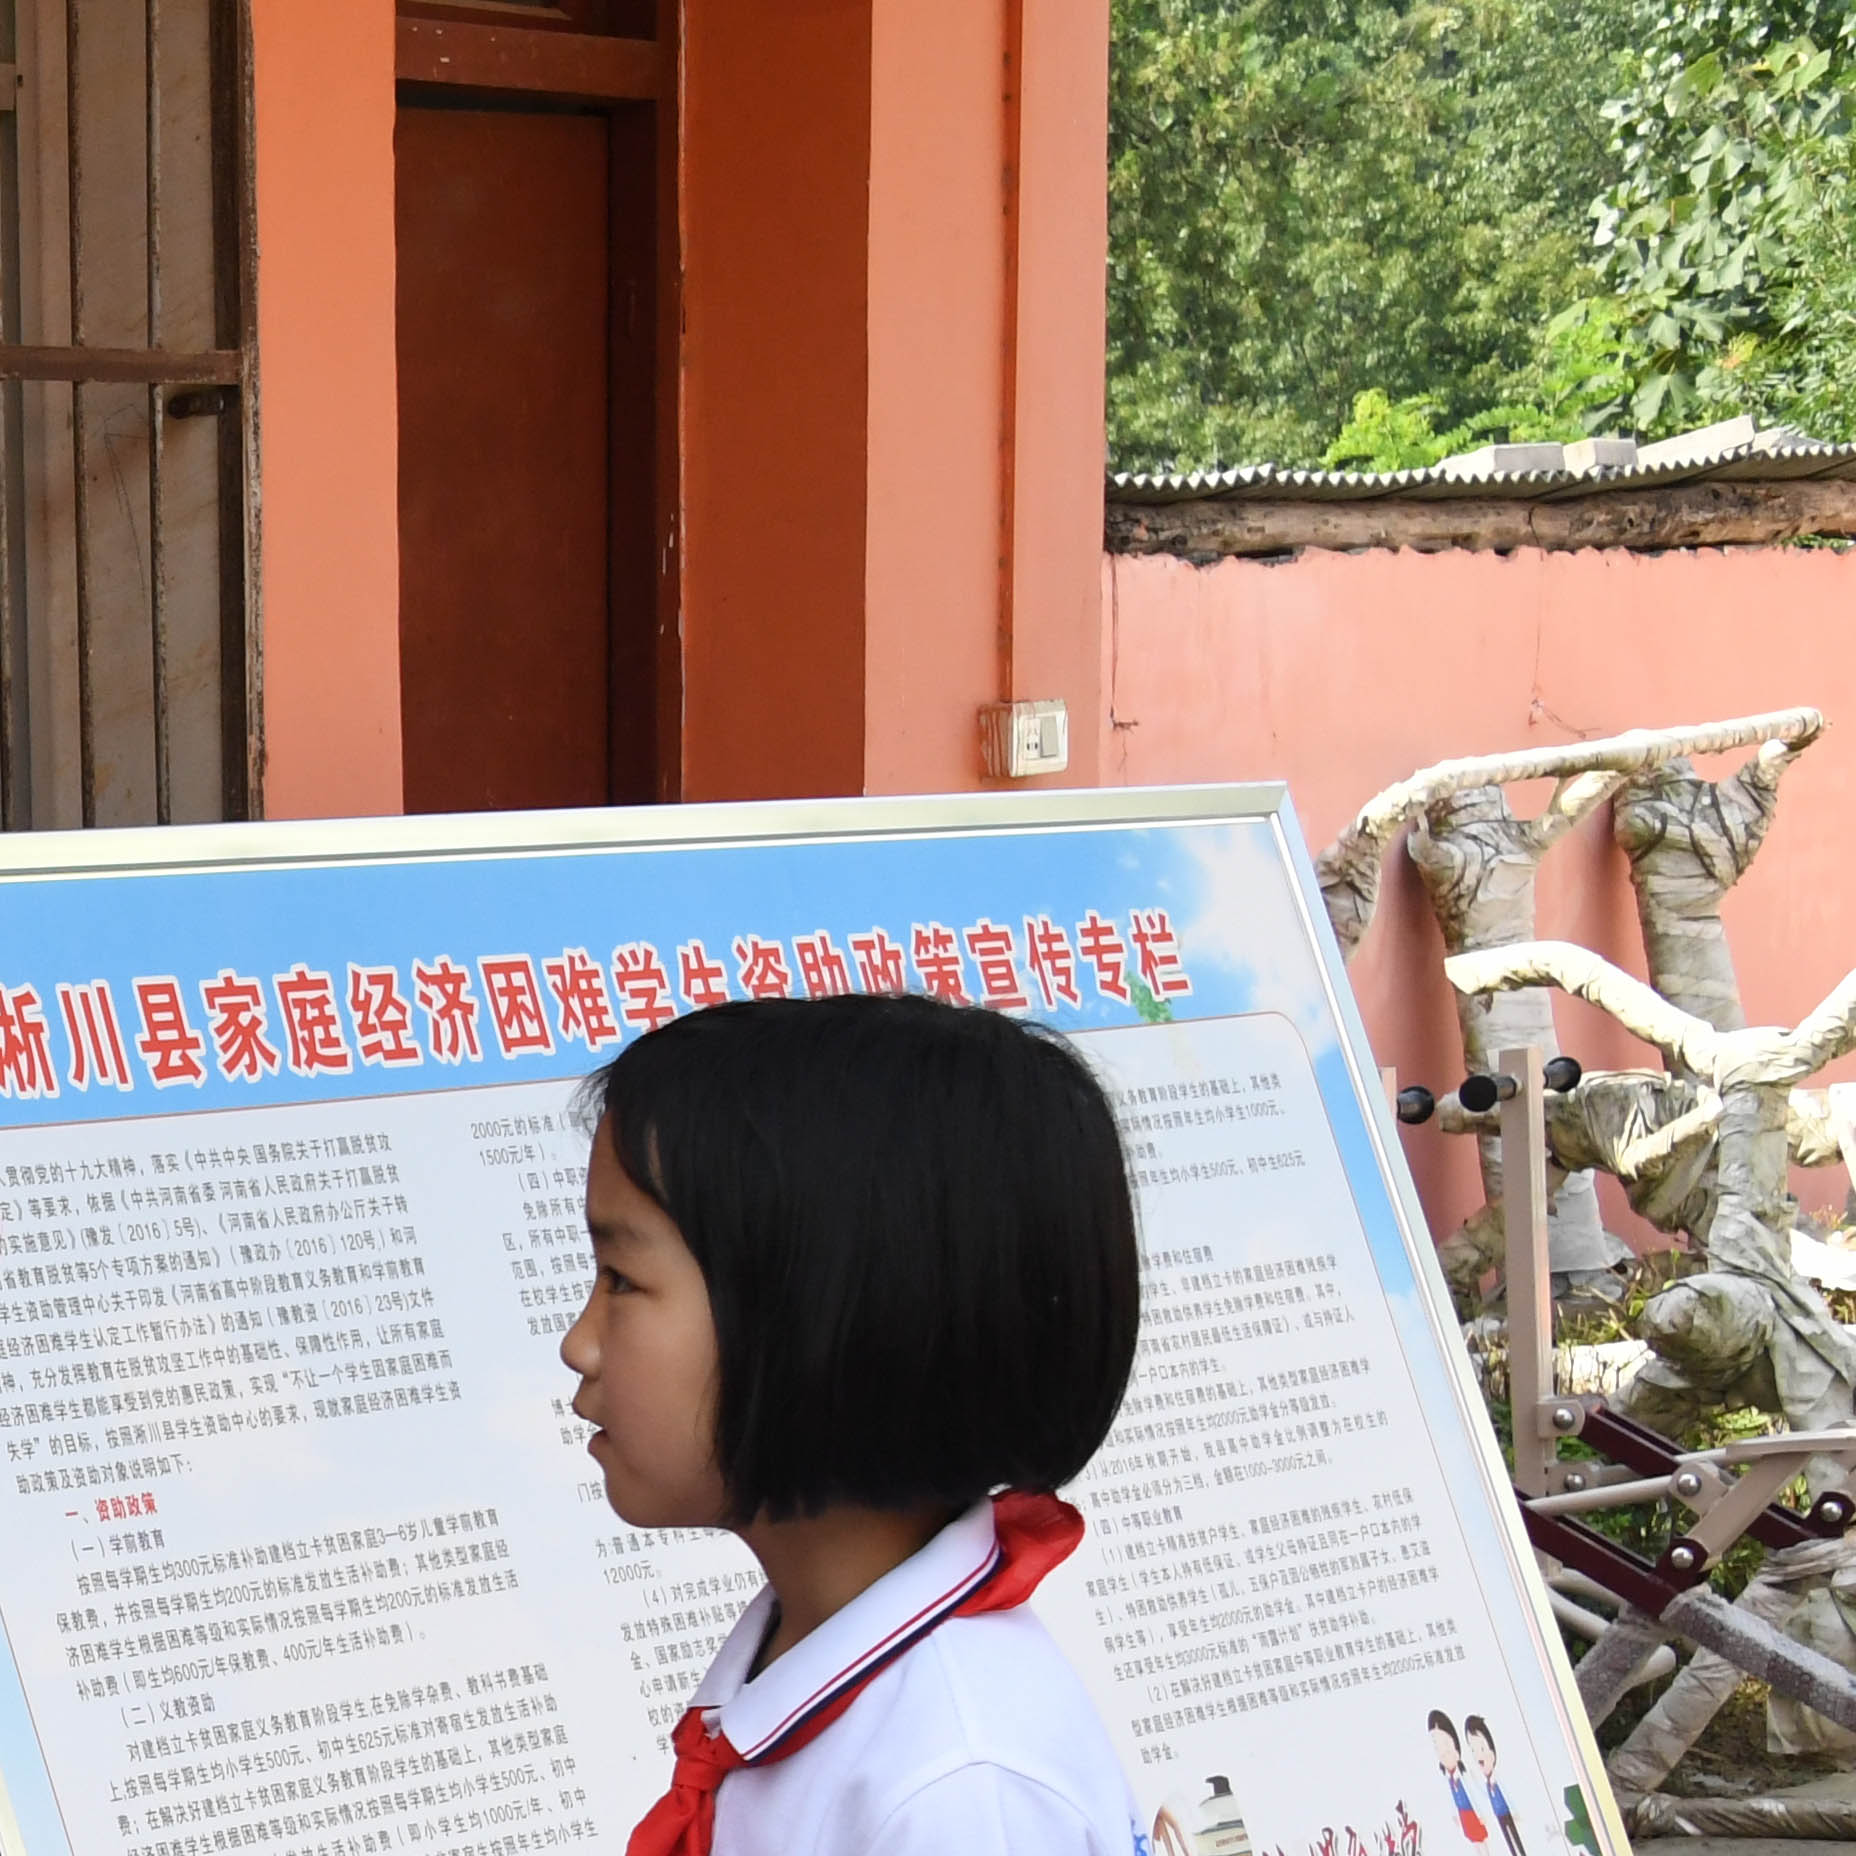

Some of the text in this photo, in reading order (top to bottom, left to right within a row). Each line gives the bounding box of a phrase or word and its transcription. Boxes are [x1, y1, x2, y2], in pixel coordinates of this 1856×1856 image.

[508, 1250, 600, 1281] 范围，按照每
[62, 1492, 159, 1528] 一、资助政策
[69, 1528, 167, 1562] （一）学前教育
[64, 1570, 521, 1670] 济困难学生根据困难等级和实际情况按照每学期生均200元的标准发放生活
[119, 1691, 217, 1729] （二）义教资助
